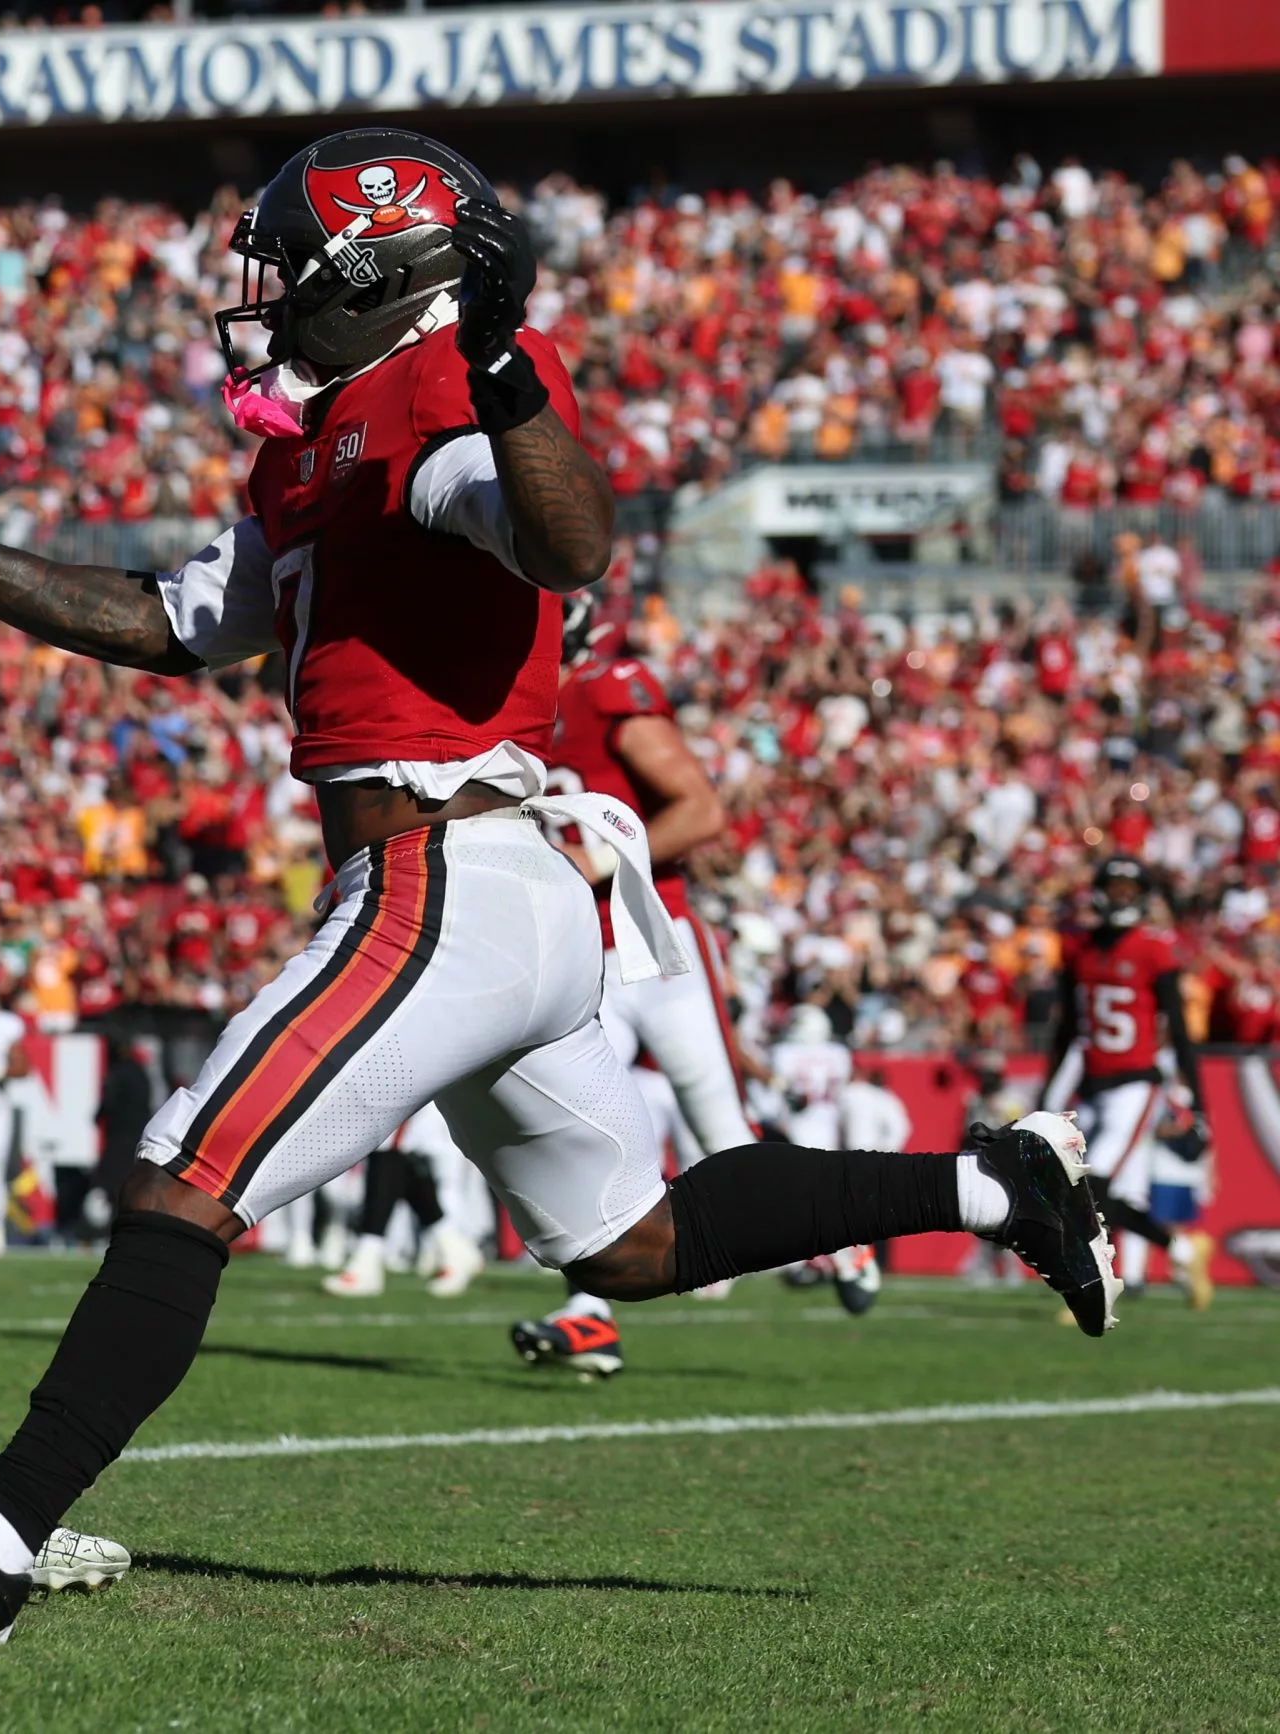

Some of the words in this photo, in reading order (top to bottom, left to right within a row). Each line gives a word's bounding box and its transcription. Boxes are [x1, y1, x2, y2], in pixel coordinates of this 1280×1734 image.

[418, 18, 707, 98] JAMES
[737, 0, 1144, 88] STADIUM
[335, 432, 360, 463] 50
